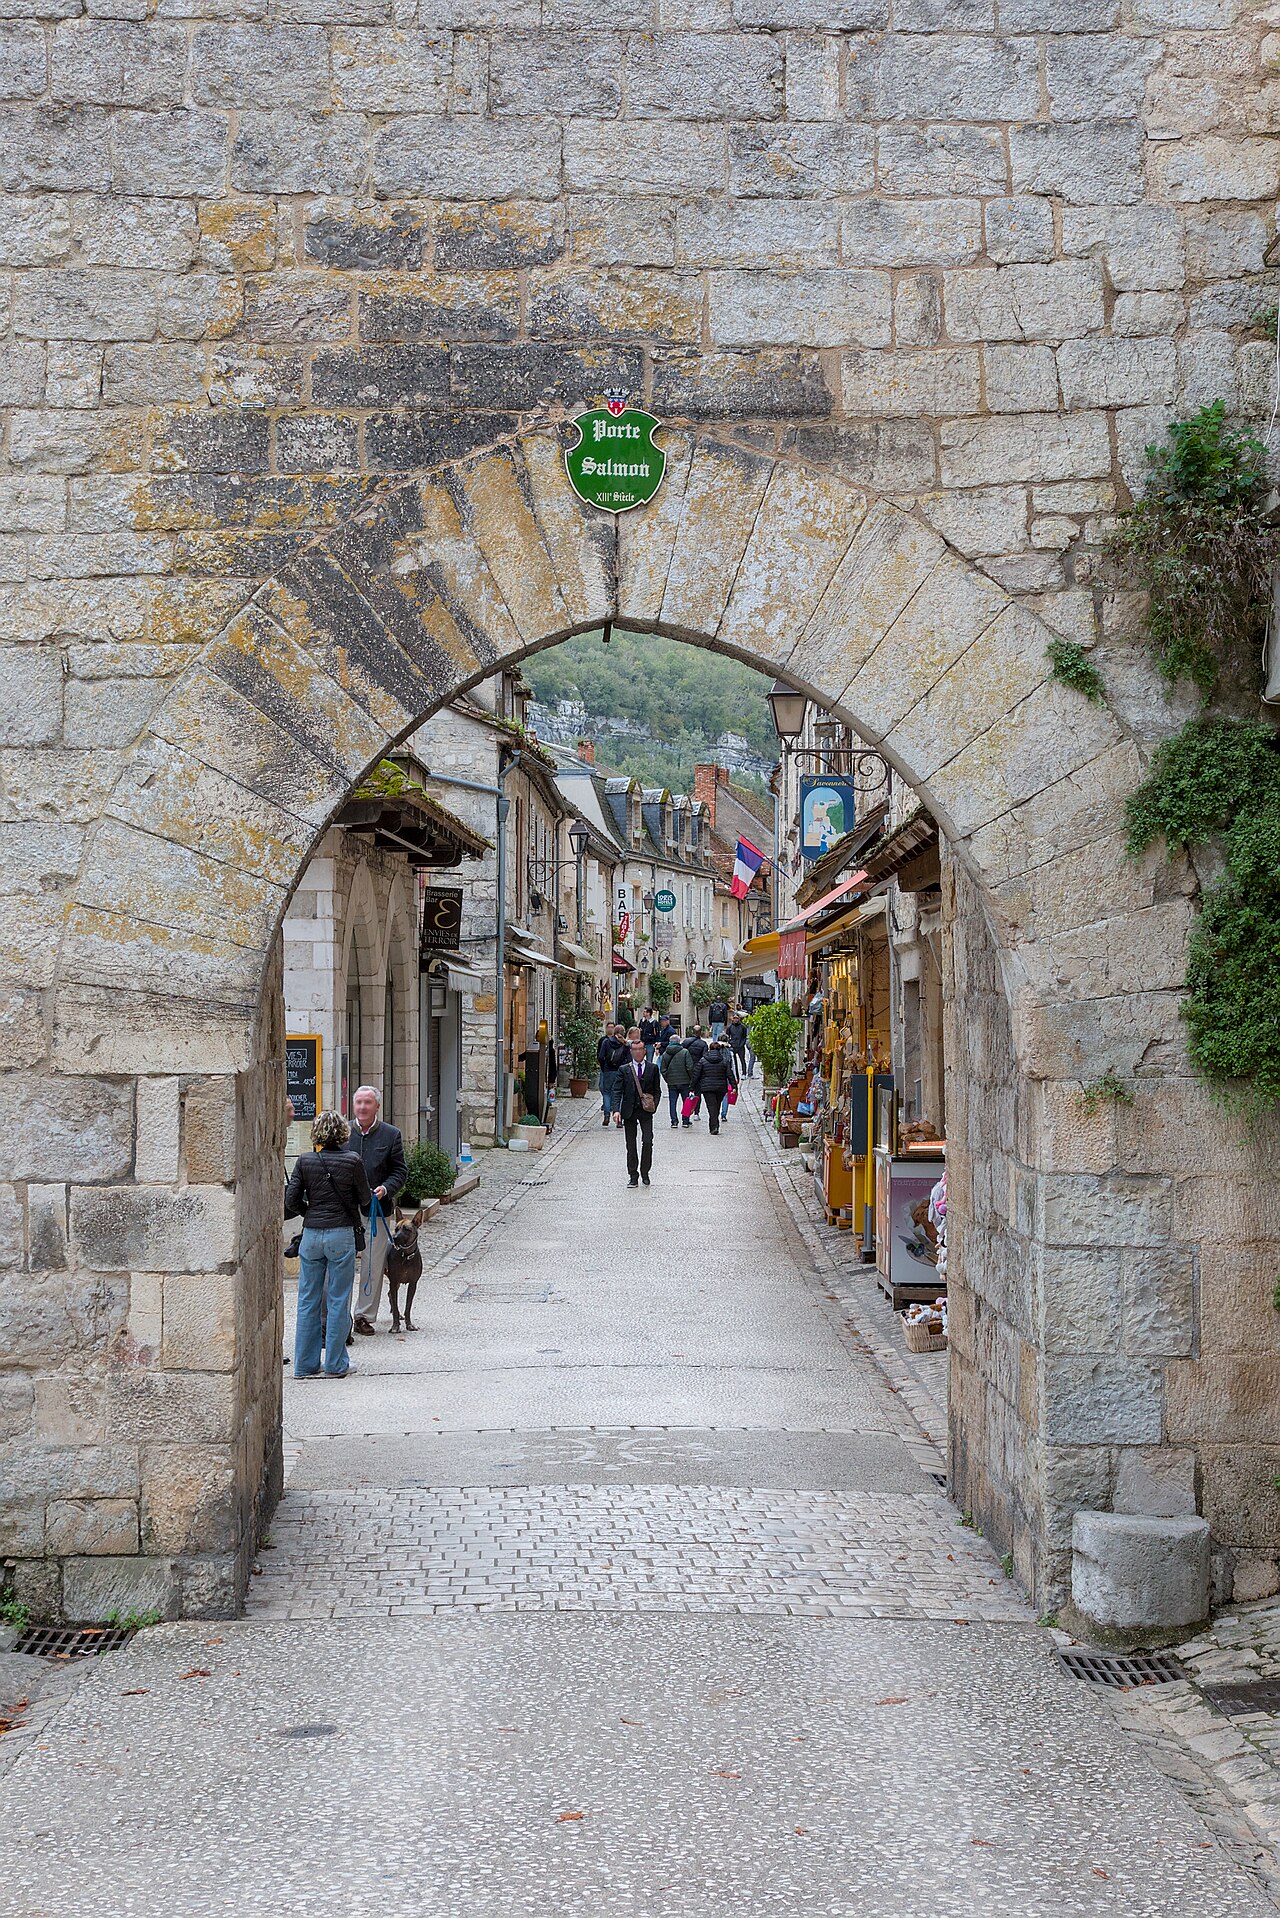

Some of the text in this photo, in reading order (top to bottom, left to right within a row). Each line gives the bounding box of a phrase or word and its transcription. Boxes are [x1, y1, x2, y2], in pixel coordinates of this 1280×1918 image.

[592, 419, 641, 442] Porte
[580, 456, 650, 477] Salmon
[613, 491, 635, 502] Siècle
[426, 889, 459, 898] Brasserie
[424, 929, 450, 937] ENVIES
[423, 936, 458, 946] TERROIR
